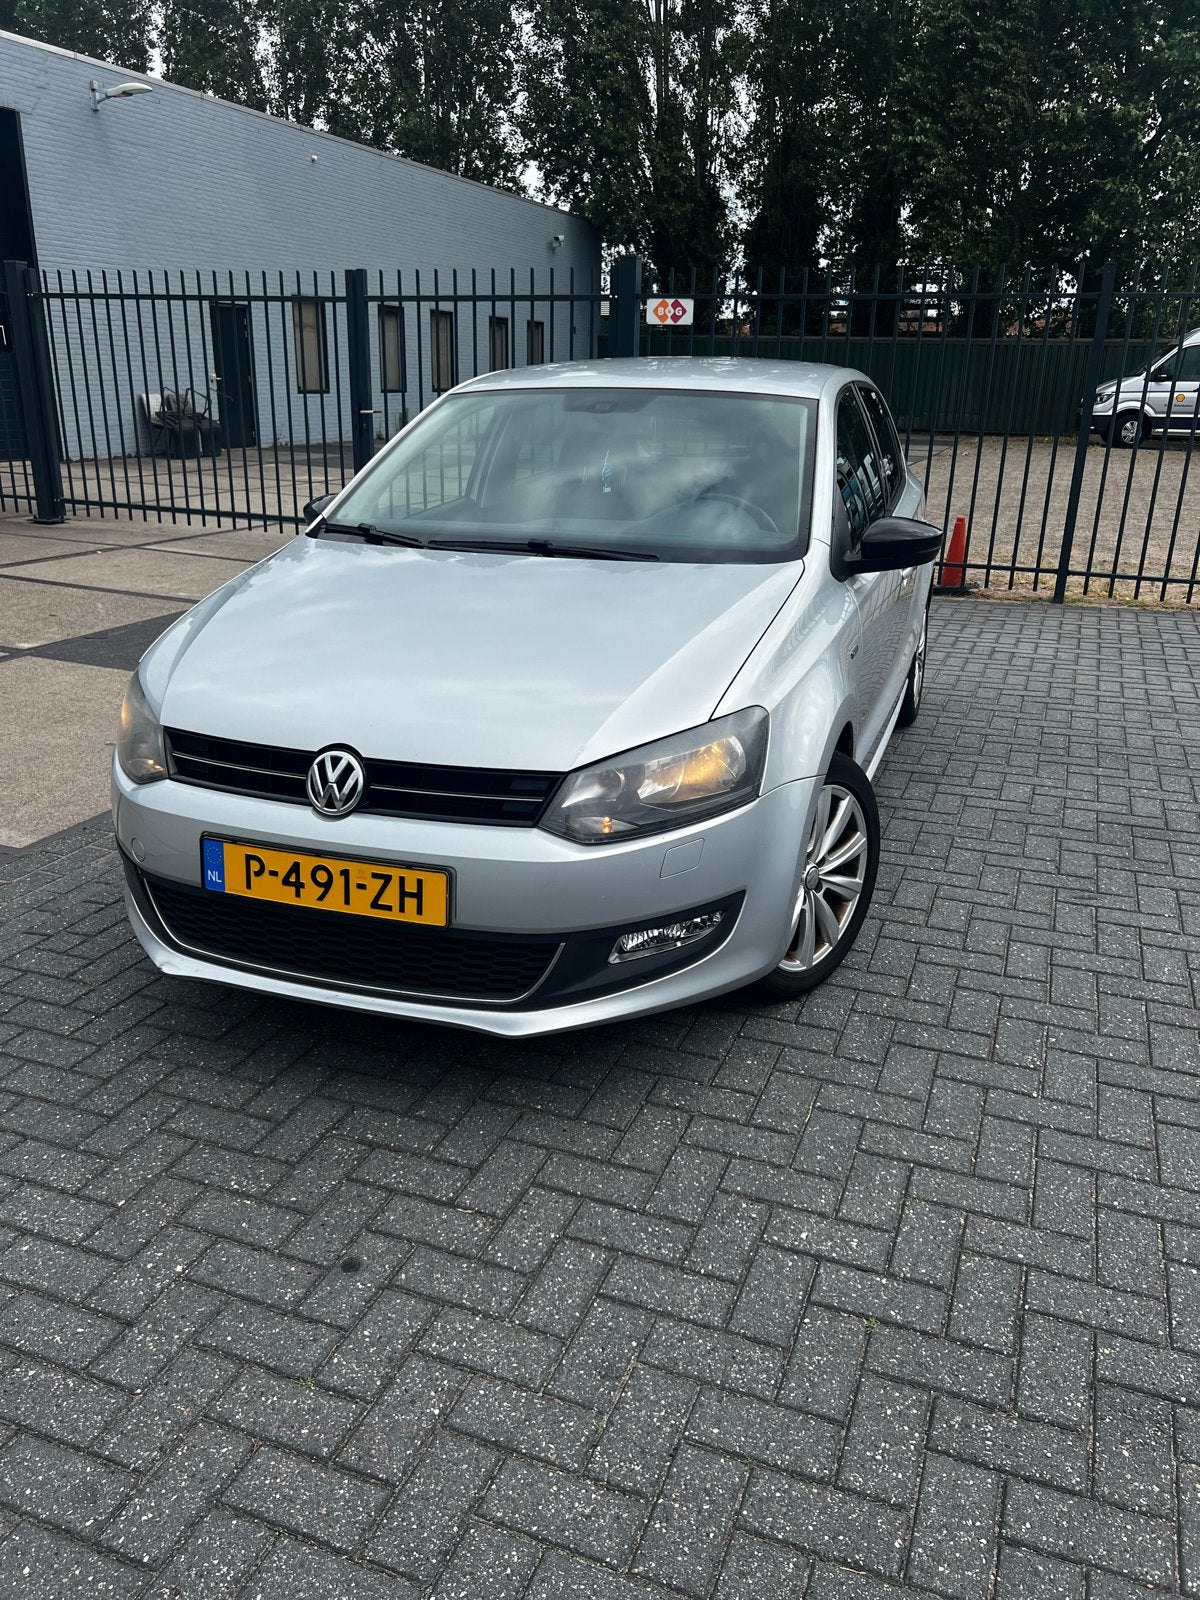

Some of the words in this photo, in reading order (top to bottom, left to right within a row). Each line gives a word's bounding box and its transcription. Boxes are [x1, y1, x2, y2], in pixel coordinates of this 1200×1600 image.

[308, 752, 363, 814] VW
[207, 869, 223, 883] NL
[244, 853, 424, 916] P-491-ZH
